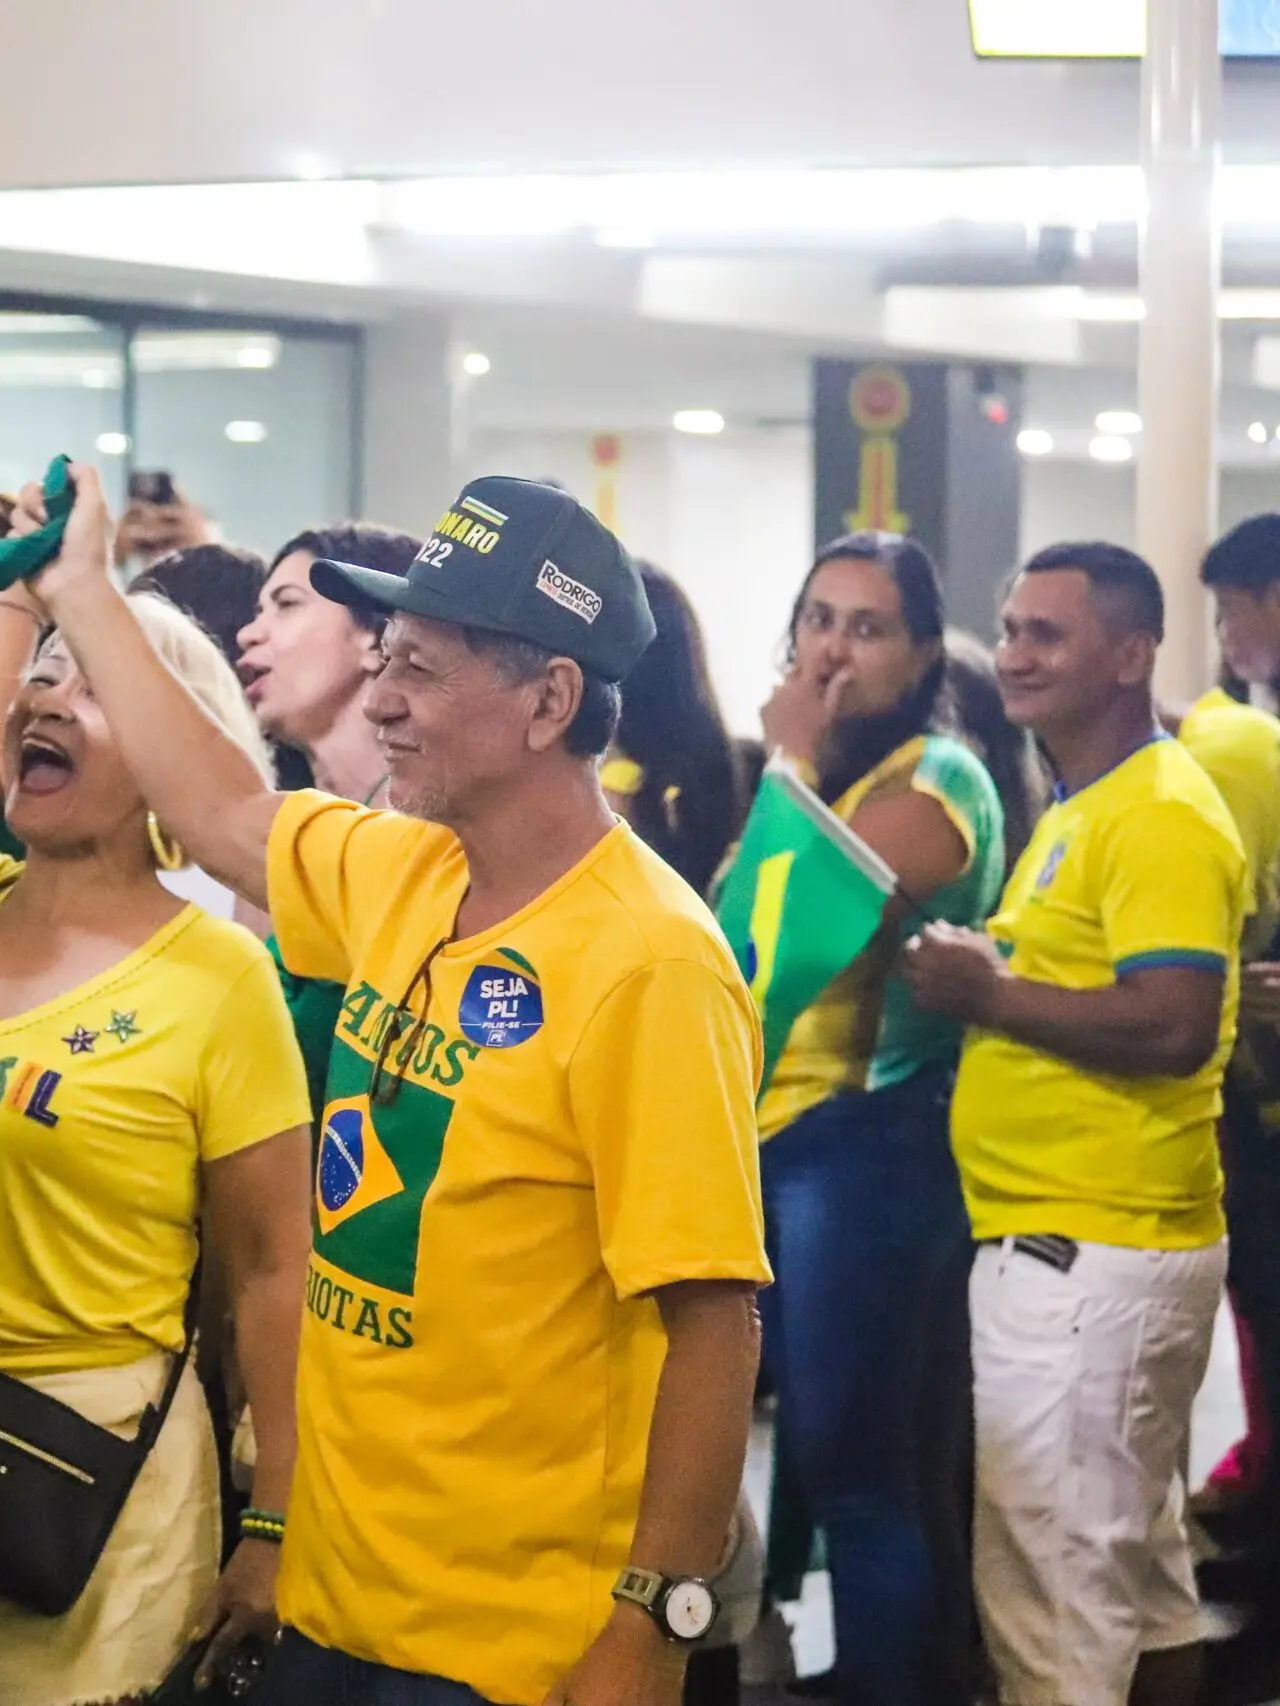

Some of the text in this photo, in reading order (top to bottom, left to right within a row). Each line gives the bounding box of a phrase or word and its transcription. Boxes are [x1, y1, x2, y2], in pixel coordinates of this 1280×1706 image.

[414, 537, 454, 569] 22
[541, 564, 601, 613] RODRIGO
[480, 977, 529, 999] SEJA
[487, 999, 519, 1019] PL!
[481, 1021, 521, 1029] FILIE-SE
[307, 1264, 414, 1349] IOTAS
